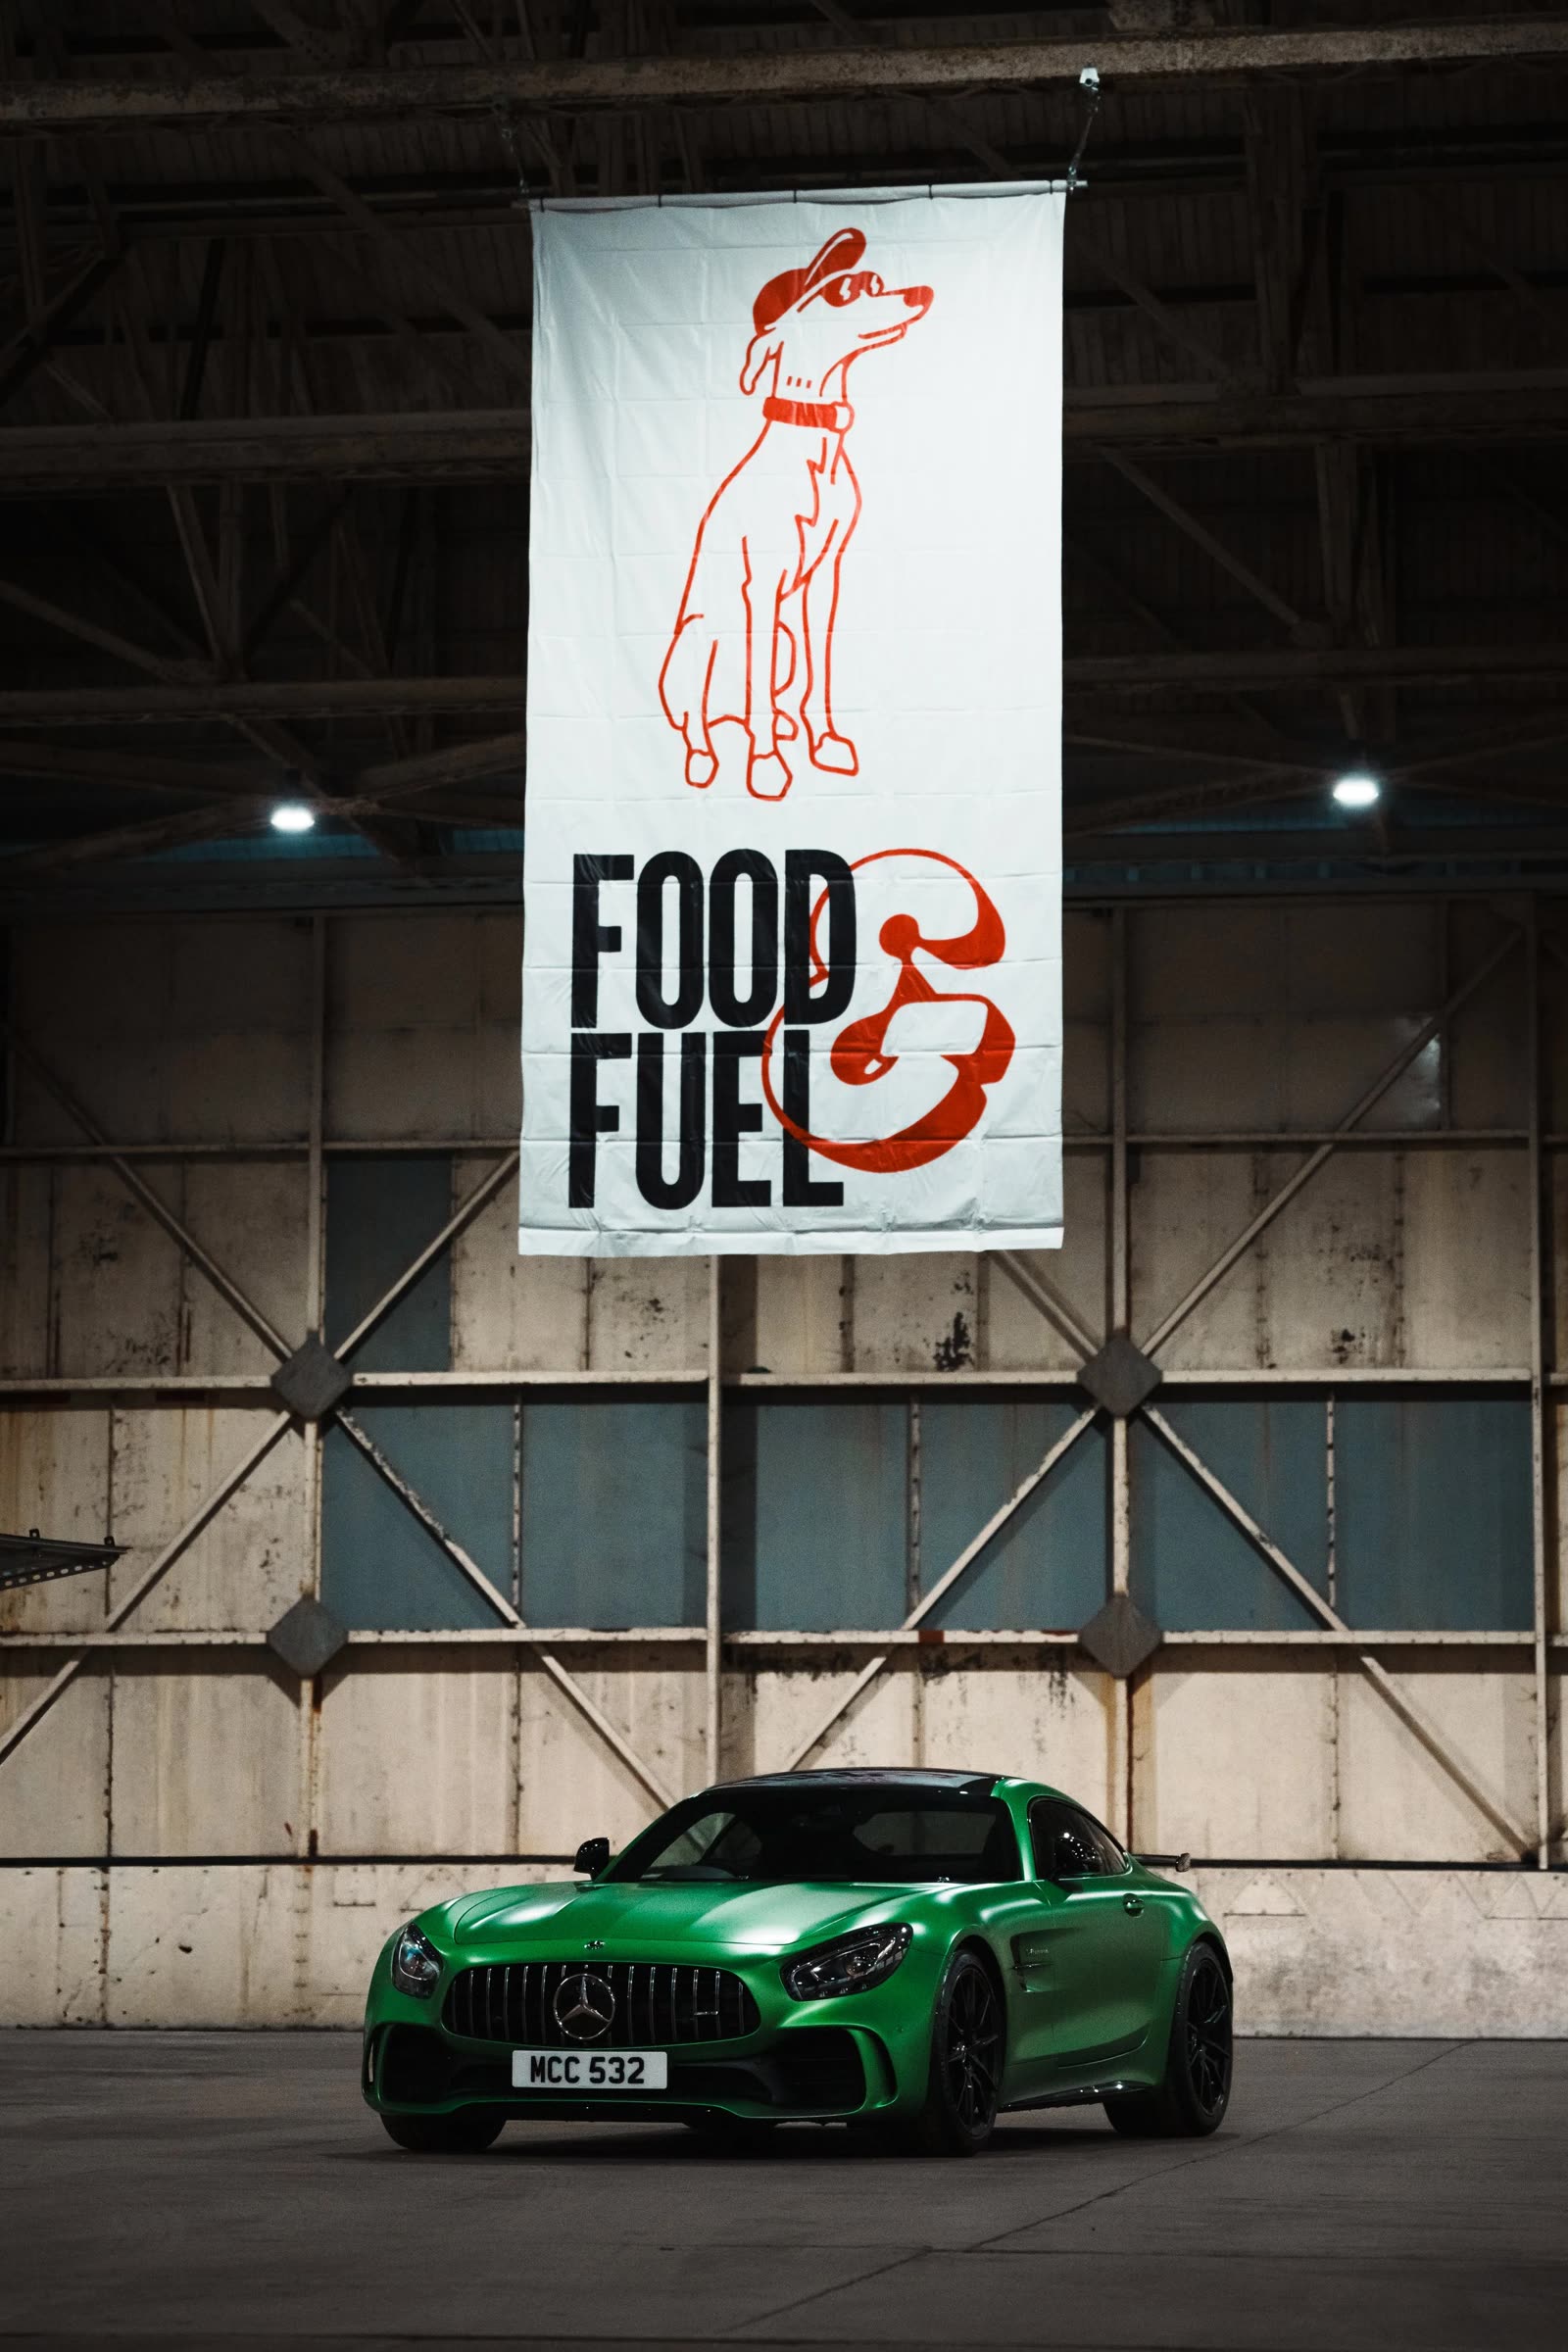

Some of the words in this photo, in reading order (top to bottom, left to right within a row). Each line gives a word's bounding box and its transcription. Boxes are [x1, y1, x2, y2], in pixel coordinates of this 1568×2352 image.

[570, 849, 857, 1029] FOOD
[761, 849, 1016, 1173] &
[568, 1029, 844, 1210] FUEL
[530, 2055, 580, 2083] MCC
[589, 2056, 645, 2084] 532
